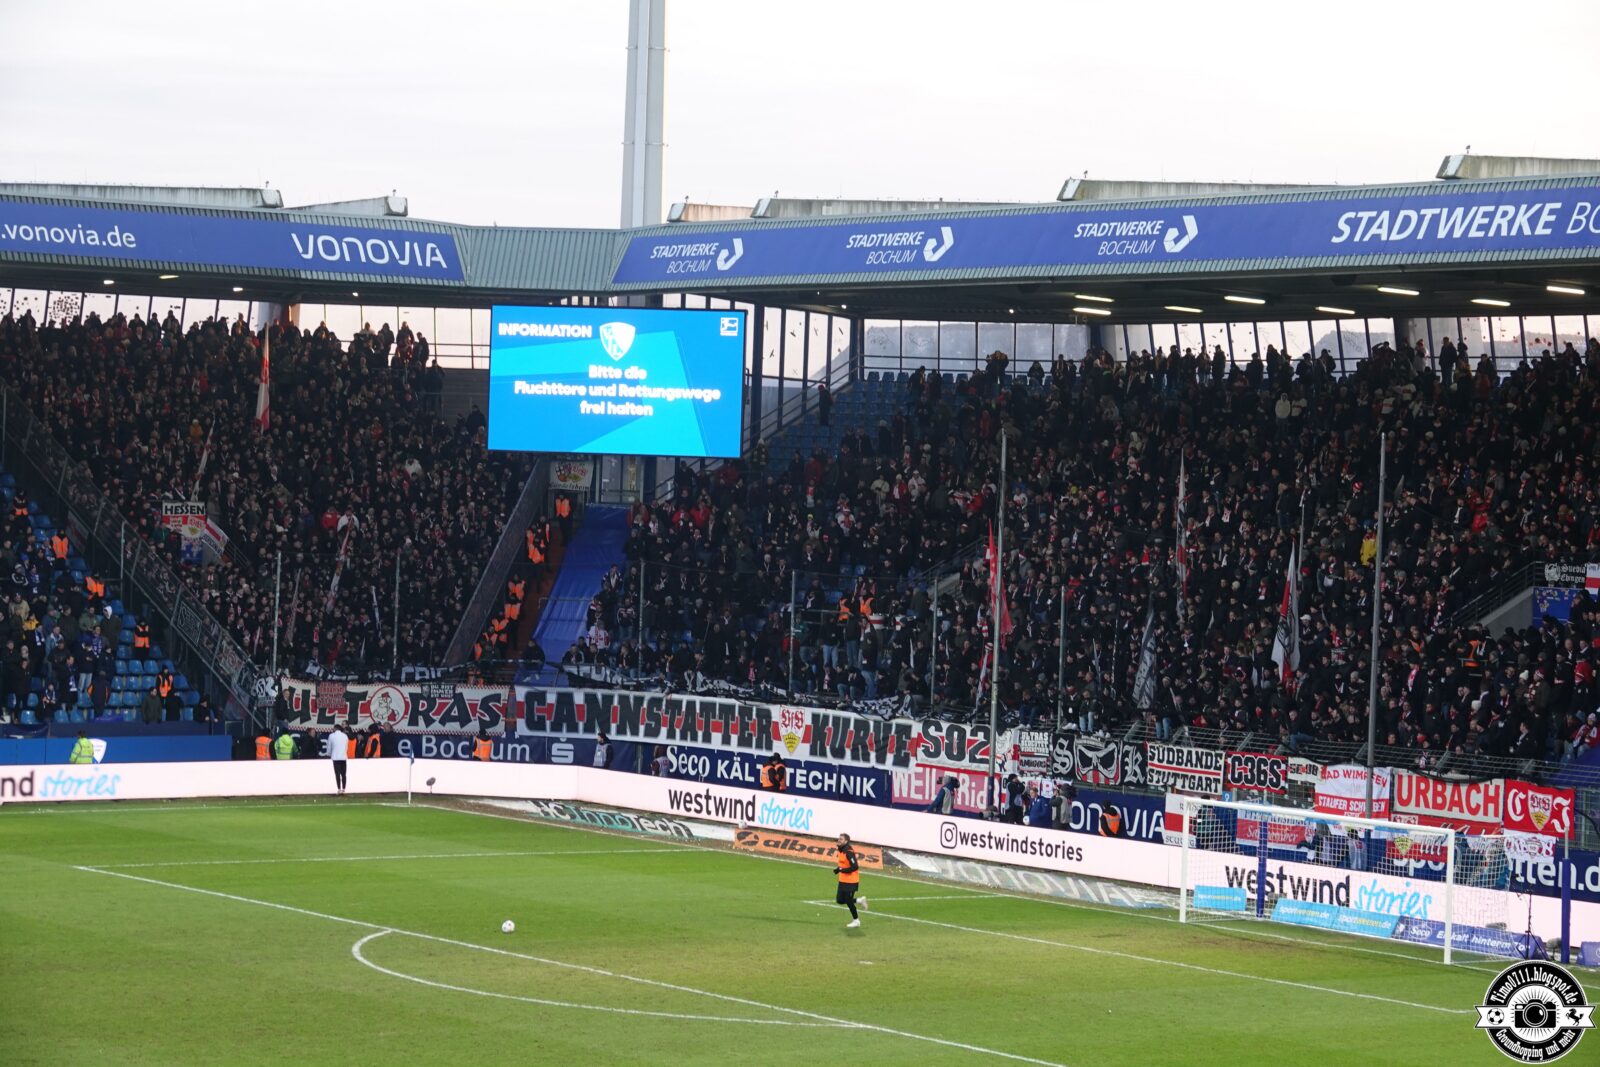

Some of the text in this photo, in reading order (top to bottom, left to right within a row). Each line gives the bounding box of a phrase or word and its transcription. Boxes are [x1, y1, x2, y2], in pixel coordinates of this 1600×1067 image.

[1074, 219, 1165, 239] STADTWERKE
[1331, 202, 1562, 244] STADTWERKE
[650, 242, 719, 260] STADTWERKE
[846, 230, 925, 249] STADTWERKE
[1098, 239, 1157, 256] BOCHUM
[666, 259, 712, 274] BOCHUM
[866, 249, 918, 265] BOCHUM
[498, 322, 593, 338] INFORMATION
[588, 364, 648, 380] Bitte die
[514, 380, 721, 403] Fluchttore und Rettungswege
[580, 400, 654, 416] frei halten
[164, 503, 205, 515] HESSEN
[524, 690, 774, 751] CANNSTATTER
[809, 712, 912, 769] KURVE
[421, 735, 530, 761] Bocum
[1149, 744, 1223, 771] SÜDBANDE
[666, 745, 710, 778] Seco
[39, 766, 121, 798] stories
[1148, 769, 1221, 794] STUTTGART
[1396, 773, 1501, 819] URBACH
[668, 787, 813, 831] westwind stories
[762, 838, 880, 864] albatos
[958, 829, 1083, 862] westwindstories
[1224, 865, 1433, 919] westwind stories
